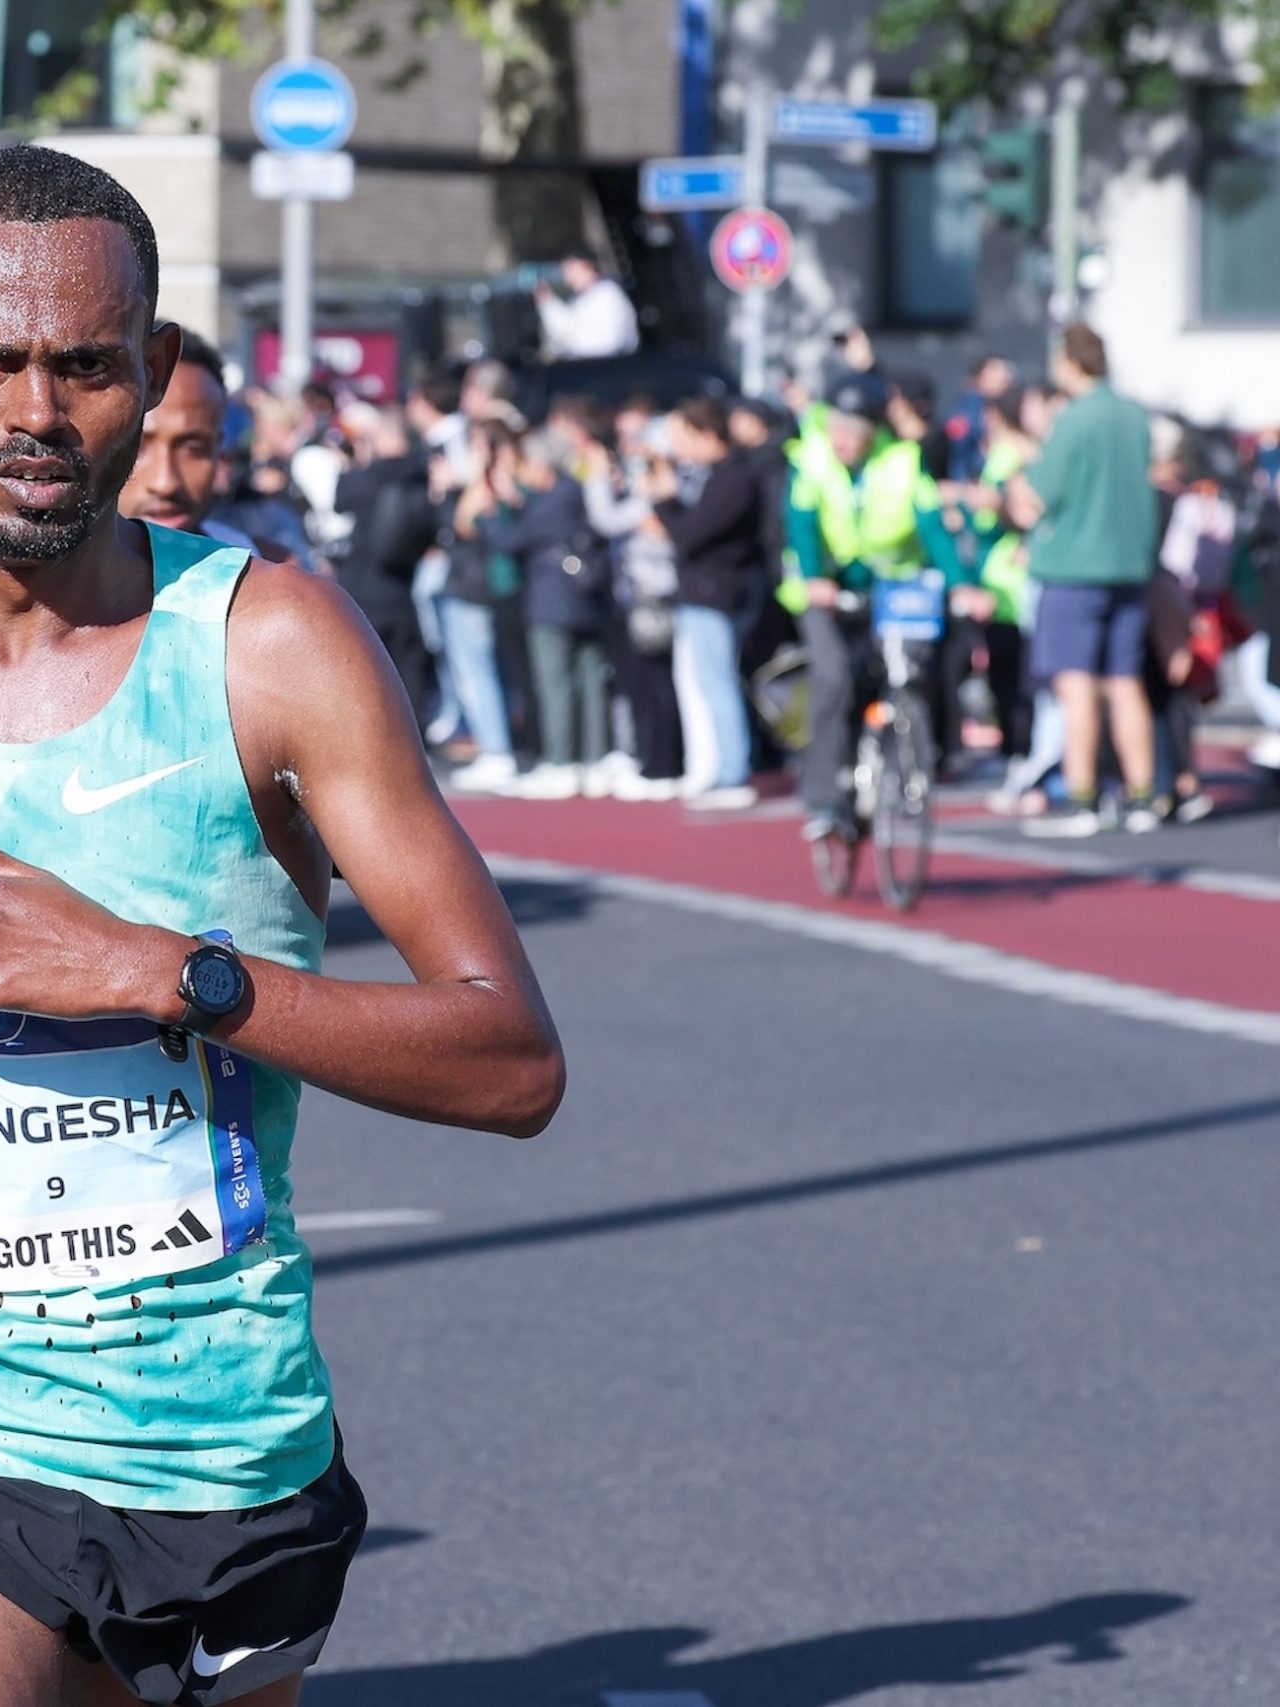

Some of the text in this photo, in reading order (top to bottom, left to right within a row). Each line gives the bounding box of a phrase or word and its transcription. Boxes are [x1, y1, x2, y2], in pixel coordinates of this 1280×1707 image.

[228, 1121, 245, 1174] EVENTS
[46, 1175, 66, 1200] 9
[60, 1223, 137, 1260] THIS
